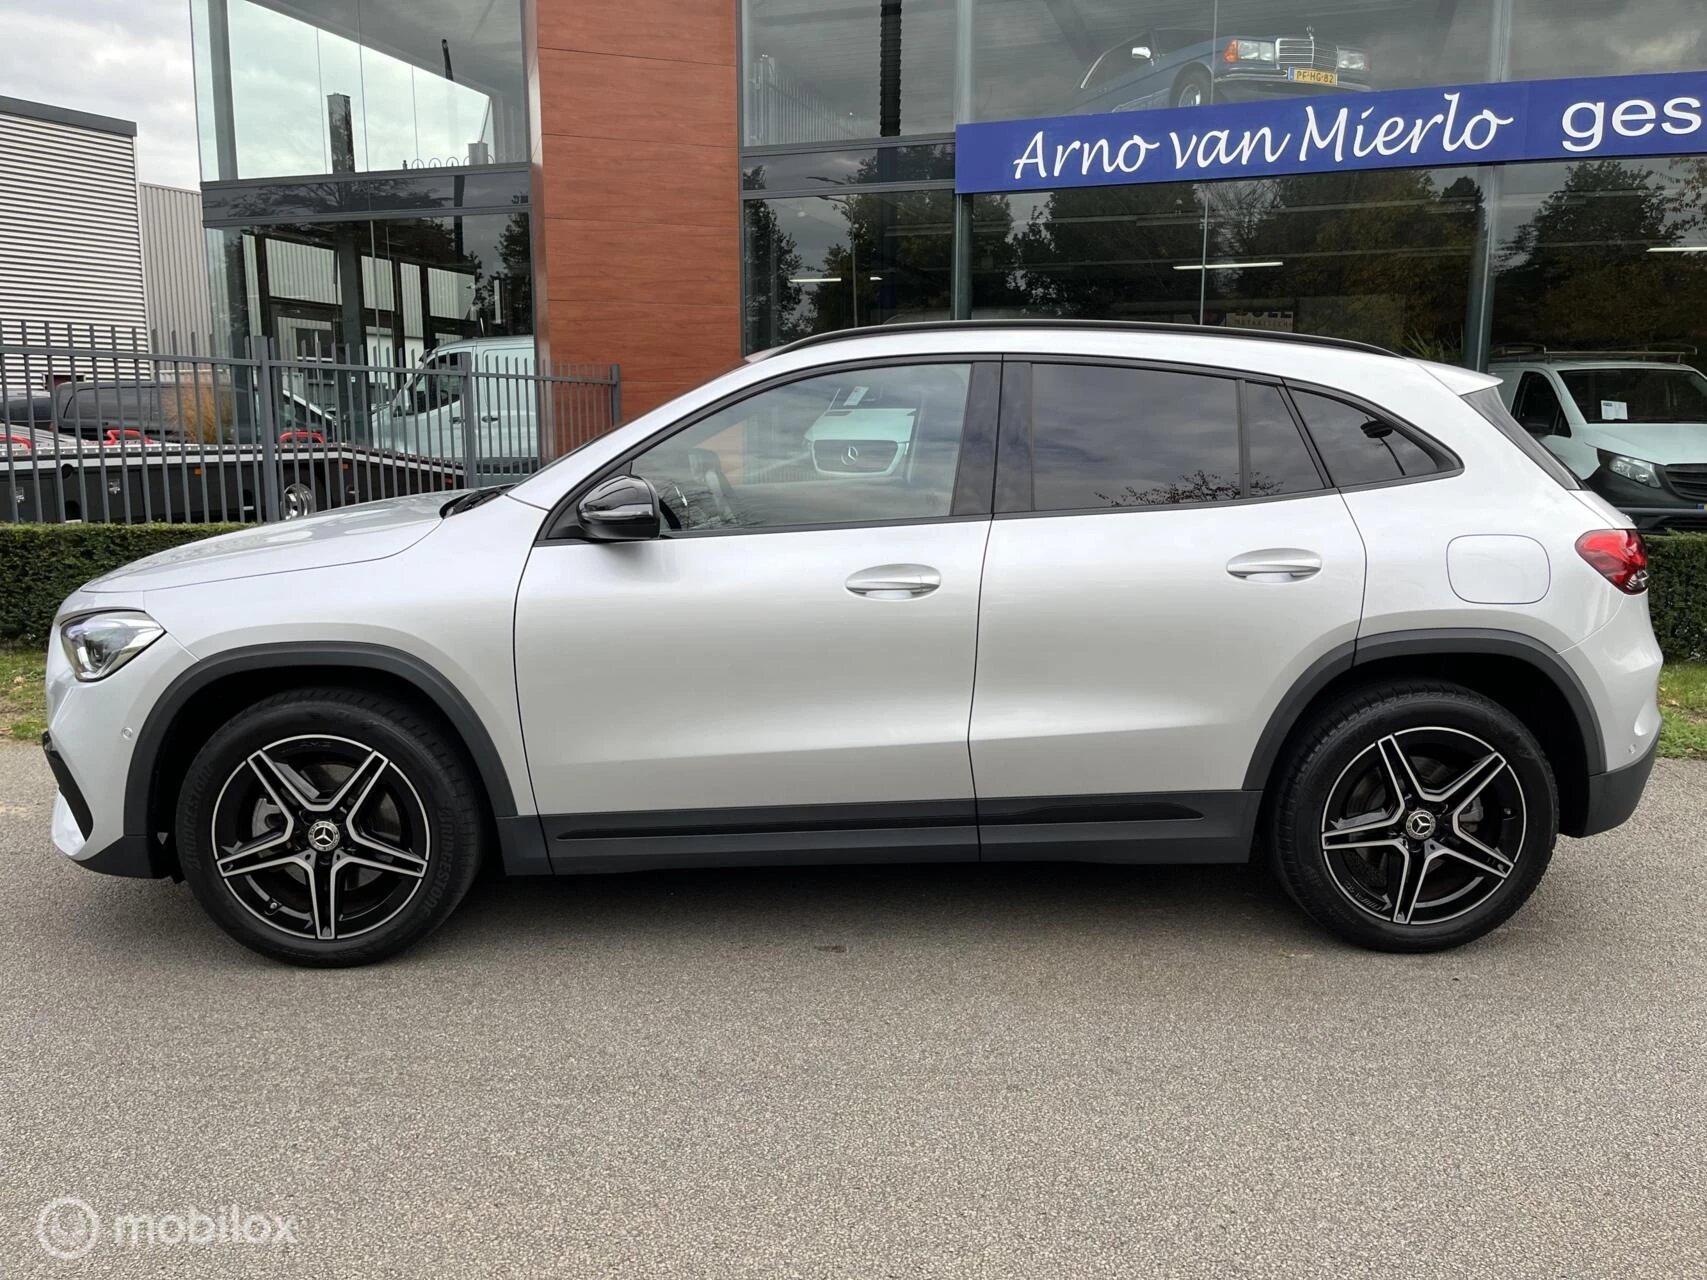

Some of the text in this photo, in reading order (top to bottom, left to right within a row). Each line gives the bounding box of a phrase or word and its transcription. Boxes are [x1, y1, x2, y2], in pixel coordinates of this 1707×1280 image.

[1013, 92, 1702, 180] Arno van Mierlo ges
